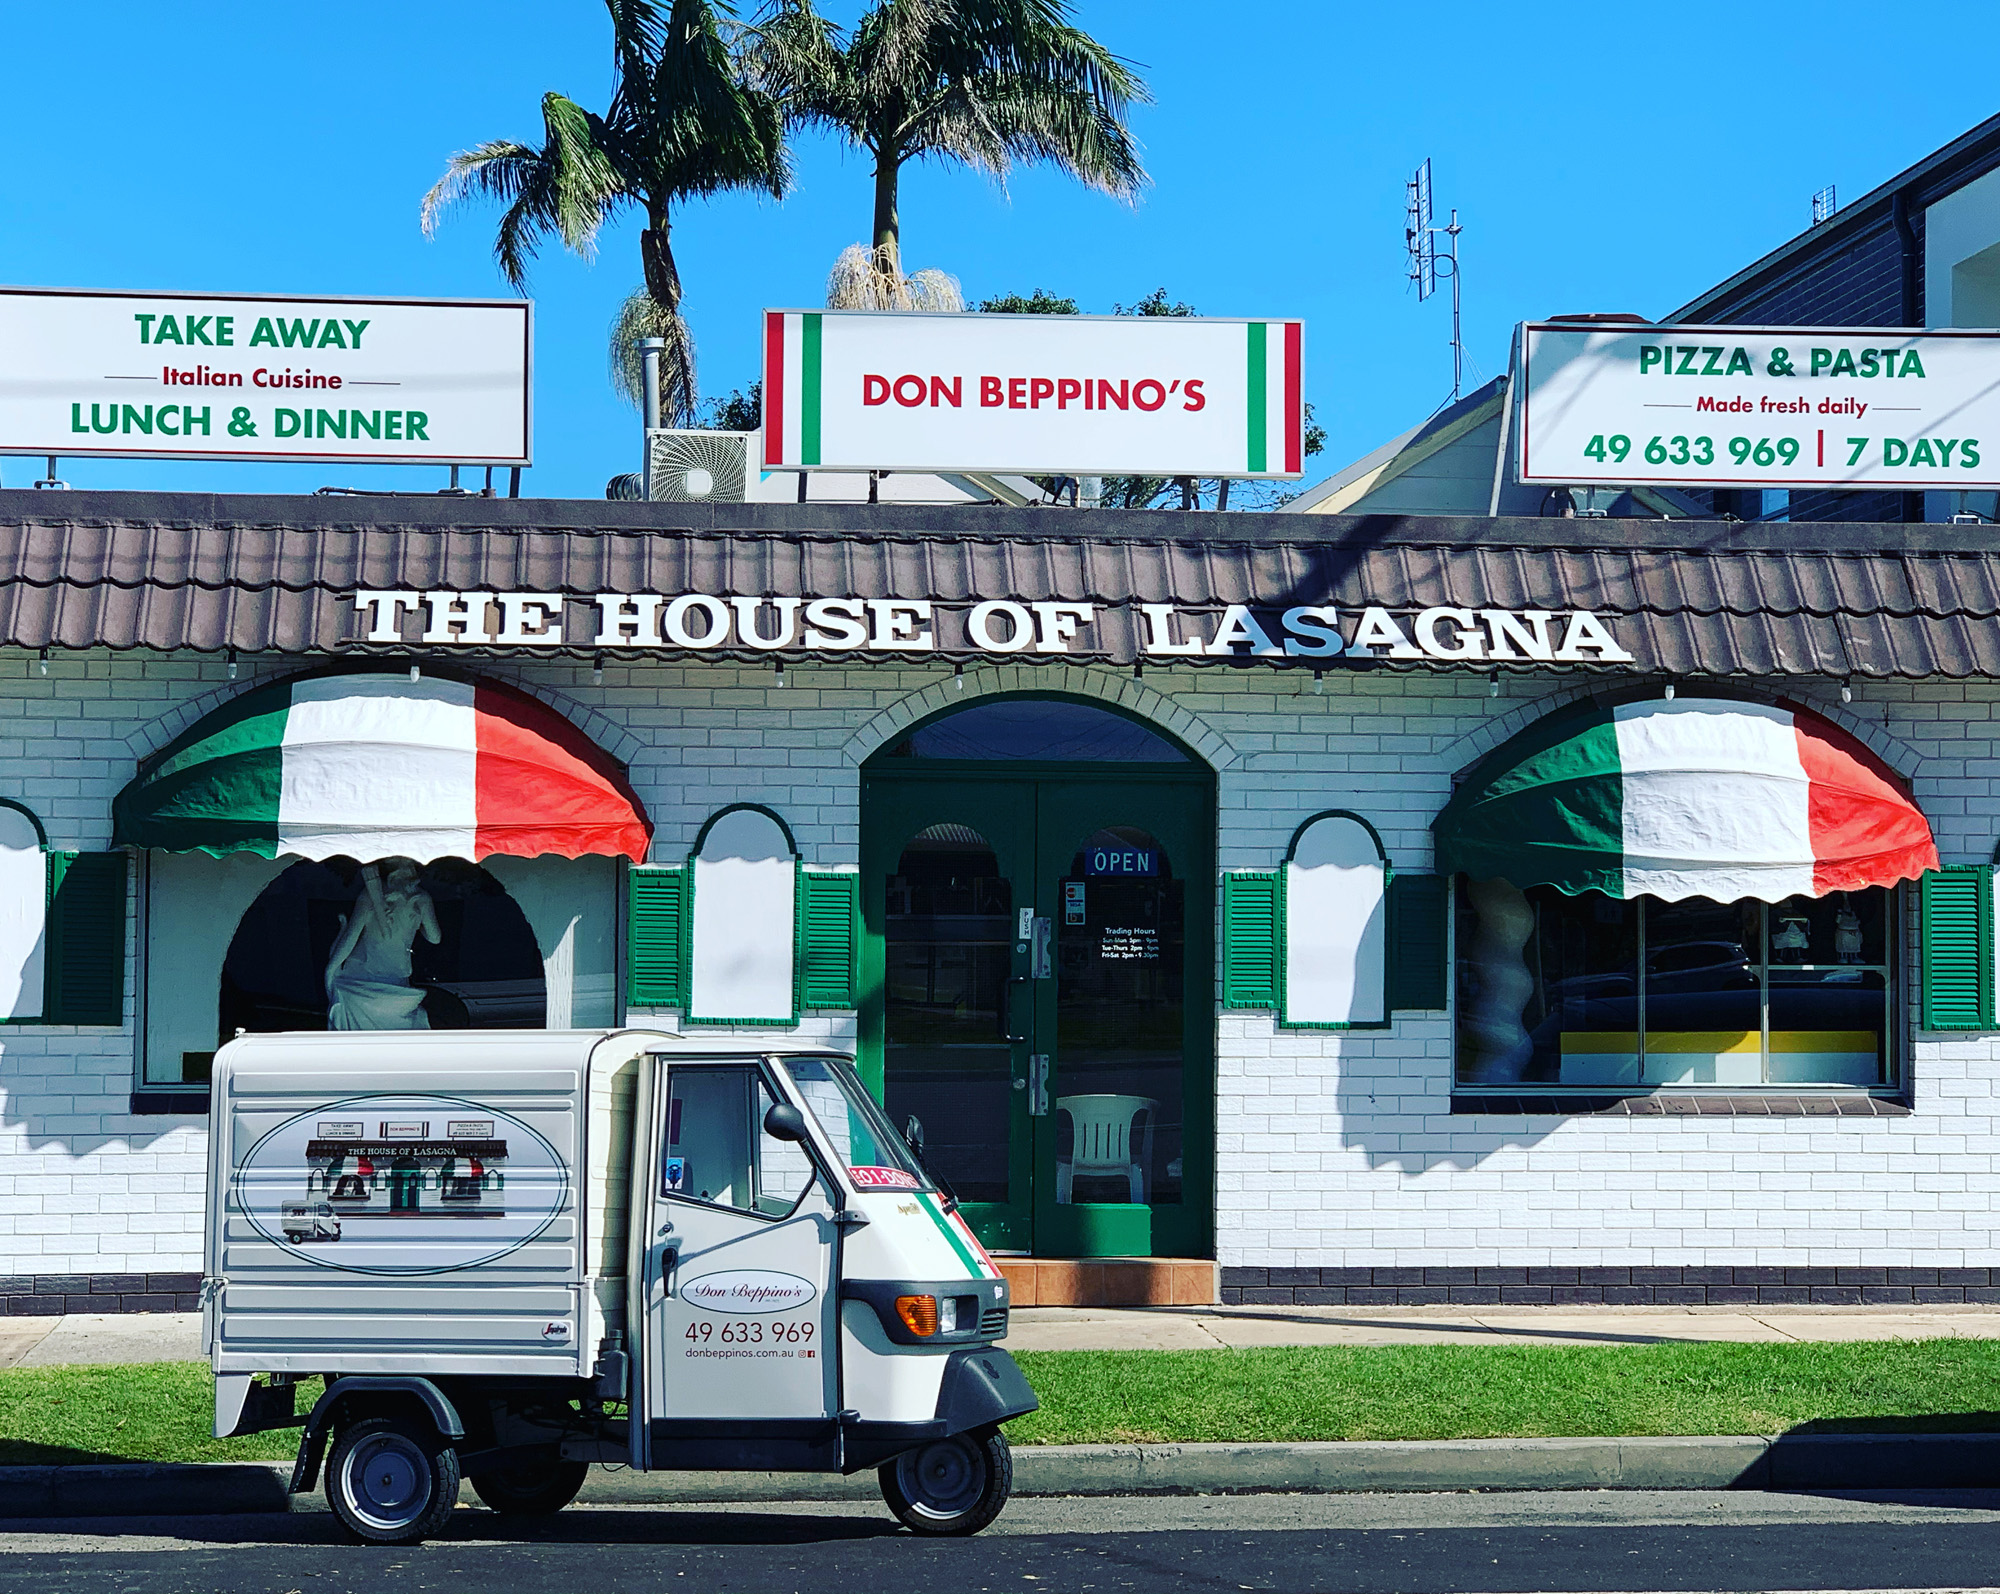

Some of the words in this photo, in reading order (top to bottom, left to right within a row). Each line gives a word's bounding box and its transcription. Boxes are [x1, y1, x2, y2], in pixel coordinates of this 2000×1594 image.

[135, 314, 234, 346] TAKE
[249, 318, 371, 349] AWAY
[1640, 346, 1752, 376] PIZZA
[1768, 347, 1796, 377] &
[1810, 348, 1926, 378] PASTA
[163, 366, 242, 386] Italian
[252, 368, 342, 389] Cuisine
[863, 374, 962, 408] DON
[980, 376, 1206, 412] BEPPINO'S
[1696, 396, 1753, 413] Made
[1760, 396, 1810, 413] fresh
[1818, 397, 1867, 419] daily
[72, 403, 211, 436] LUNCH
[227, 406, 259, 438] &
[275, 408, 430, 440] DINNER
[1584, 434, 1632, 463] 49
[1644, 436, 1715, 465] 633
[1728, 437, 1800, 467] 969
[1847, 438, 1869, 467] 7
[1884, 438, 1980, 468] DAYS
[356, 590, 563, 645] THE
[595, 594, 934, 651] HOUSE
[968, 600, 1094, 653] OF
[1142, 604, 1635, 662] LASAGNA
[1094, 852, 1149, 871] OPEN
[1105, 927, 1132, 936] Trading
[1133, 927, 1156, 935] Hours
[367, 1148, 397, 1156] HOUSE
[413, 1148, 457, 1156] LASAGNA
[694, 1283, 726, 1298] Don
[731, 1283, 802, 1303] Beppino's
[685, 1322, 713, 1343] 49
[721, 1322, 763, 1343] 633
[771, 1322, 815, 1343] 969
[685, 1347, 794, 1359] donbeppinos.com.au
